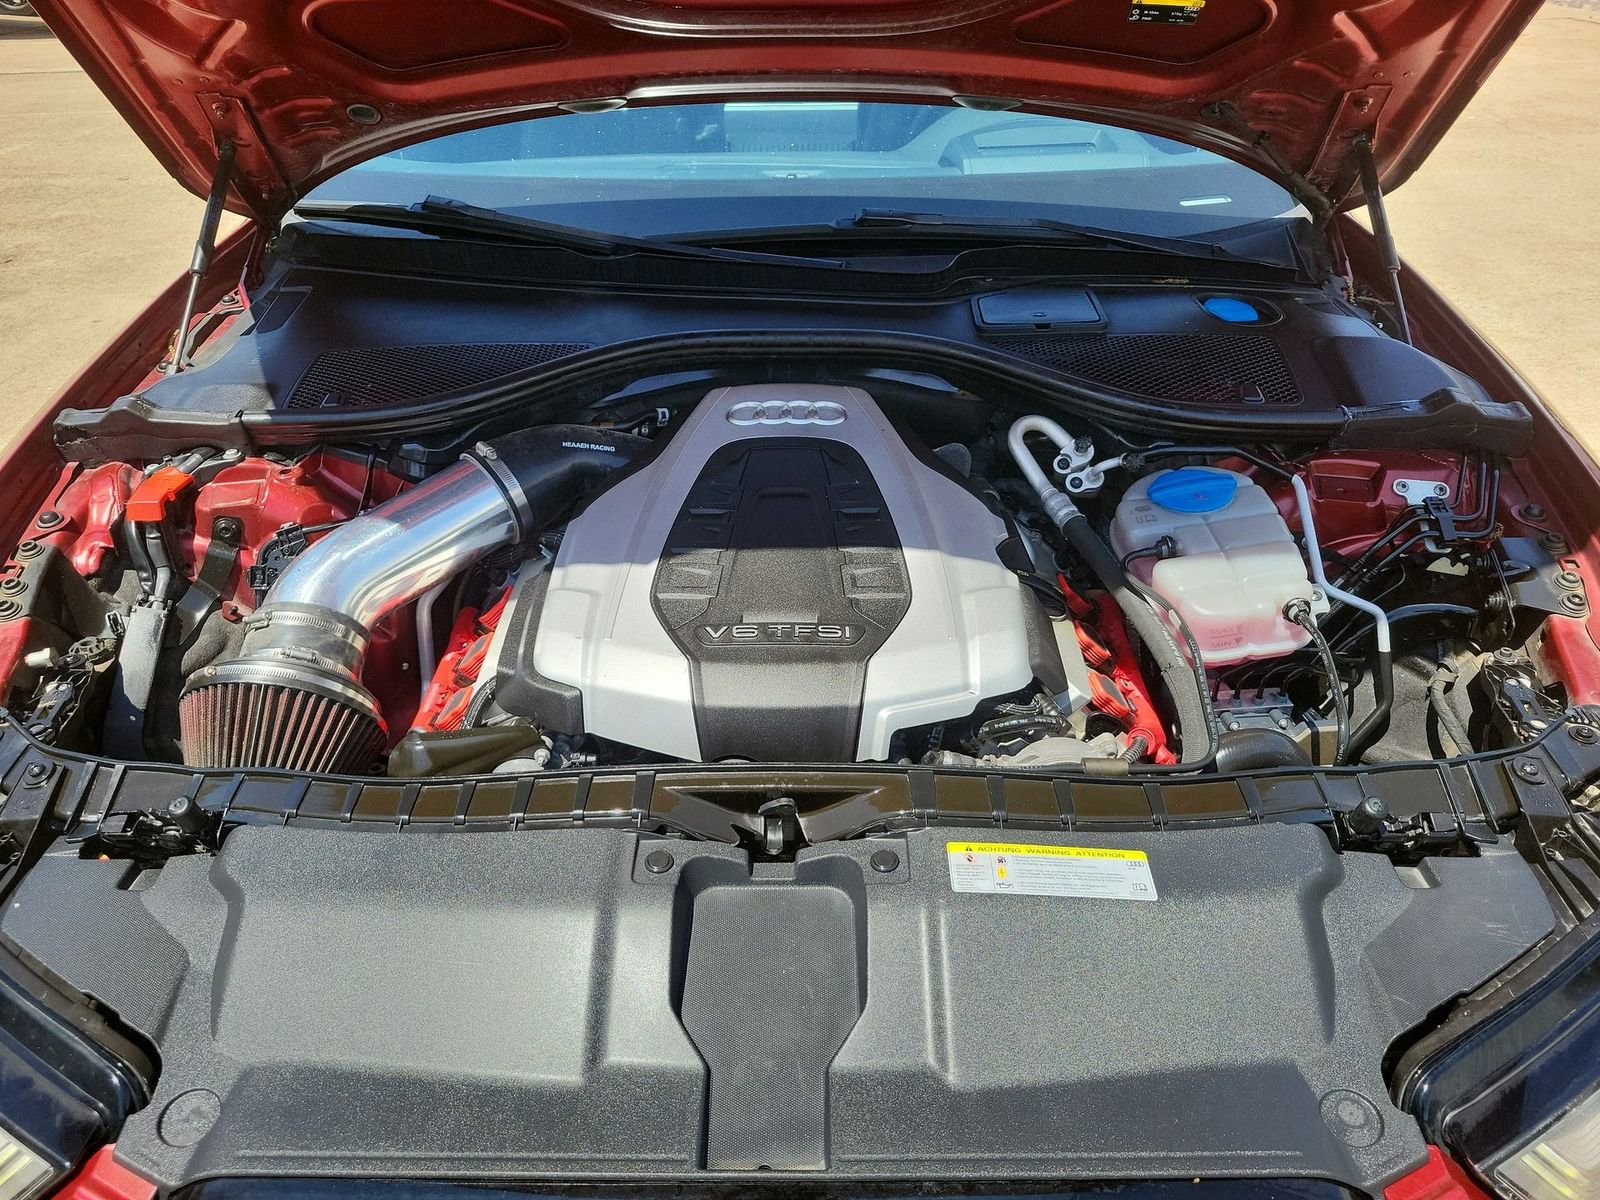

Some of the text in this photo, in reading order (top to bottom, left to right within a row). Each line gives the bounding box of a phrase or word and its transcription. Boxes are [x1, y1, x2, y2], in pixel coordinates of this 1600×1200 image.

[590, 443, 616, 452] RACING
[704, 624, 851, 640] V6 TFSI
[1209, 640, 1232, 649] MIN
[977, 846, 1126, 859] ACHTUNG WARNING ATTENTION
